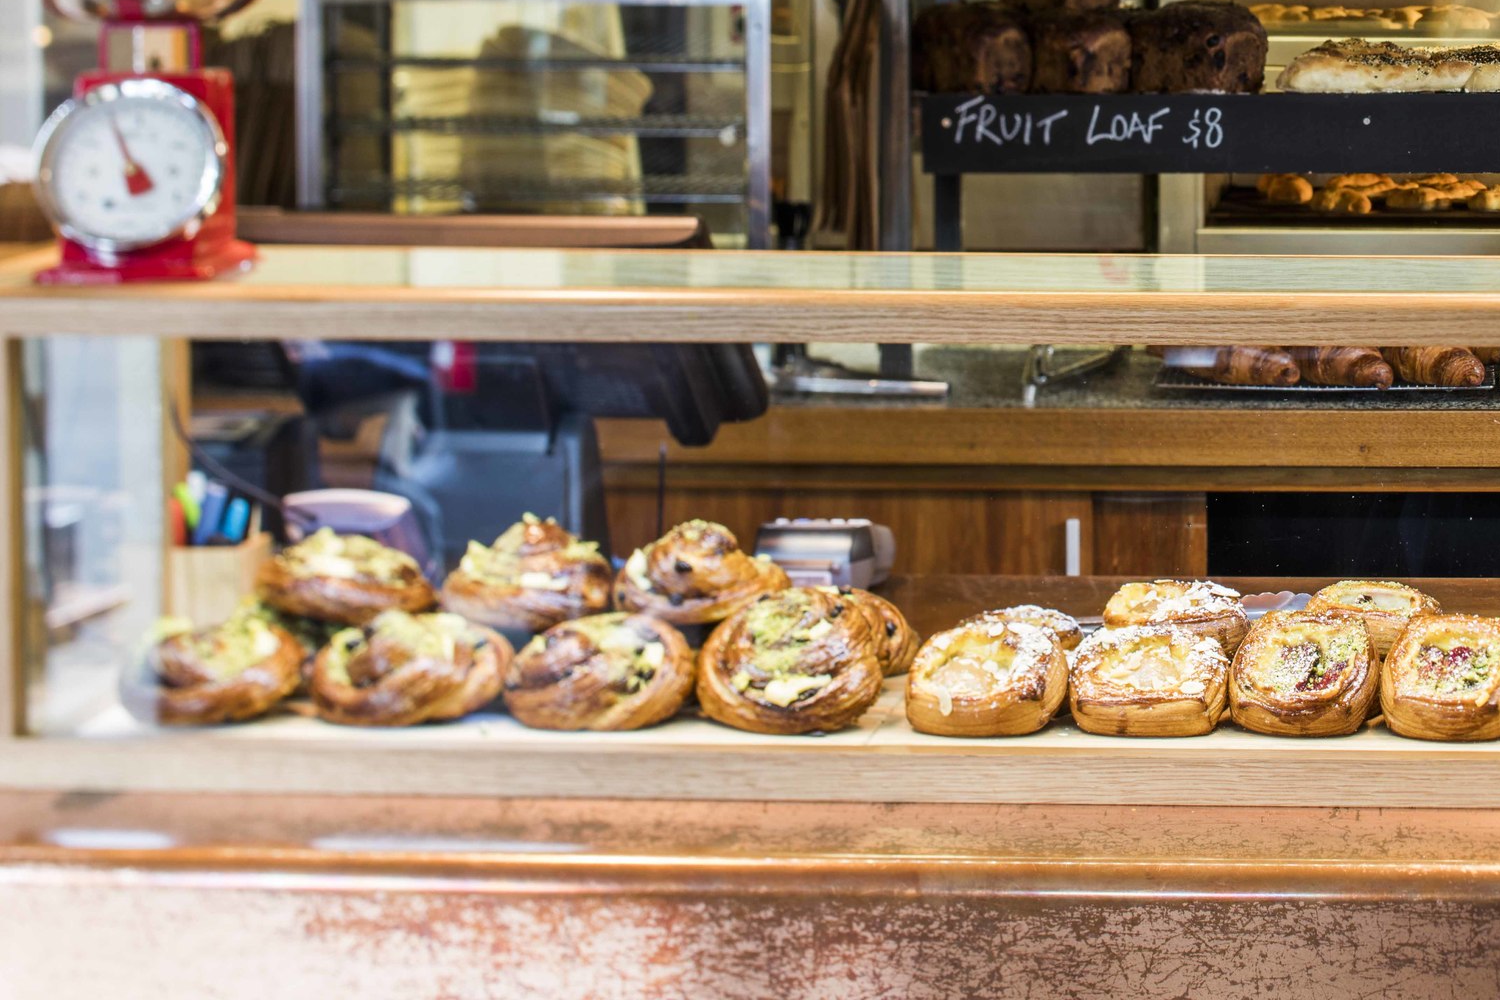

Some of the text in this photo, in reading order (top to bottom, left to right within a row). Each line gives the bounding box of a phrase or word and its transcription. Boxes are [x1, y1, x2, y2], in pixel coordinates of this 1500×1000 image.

[954, 95, 1224, 149] FRUIT LOAF $8
